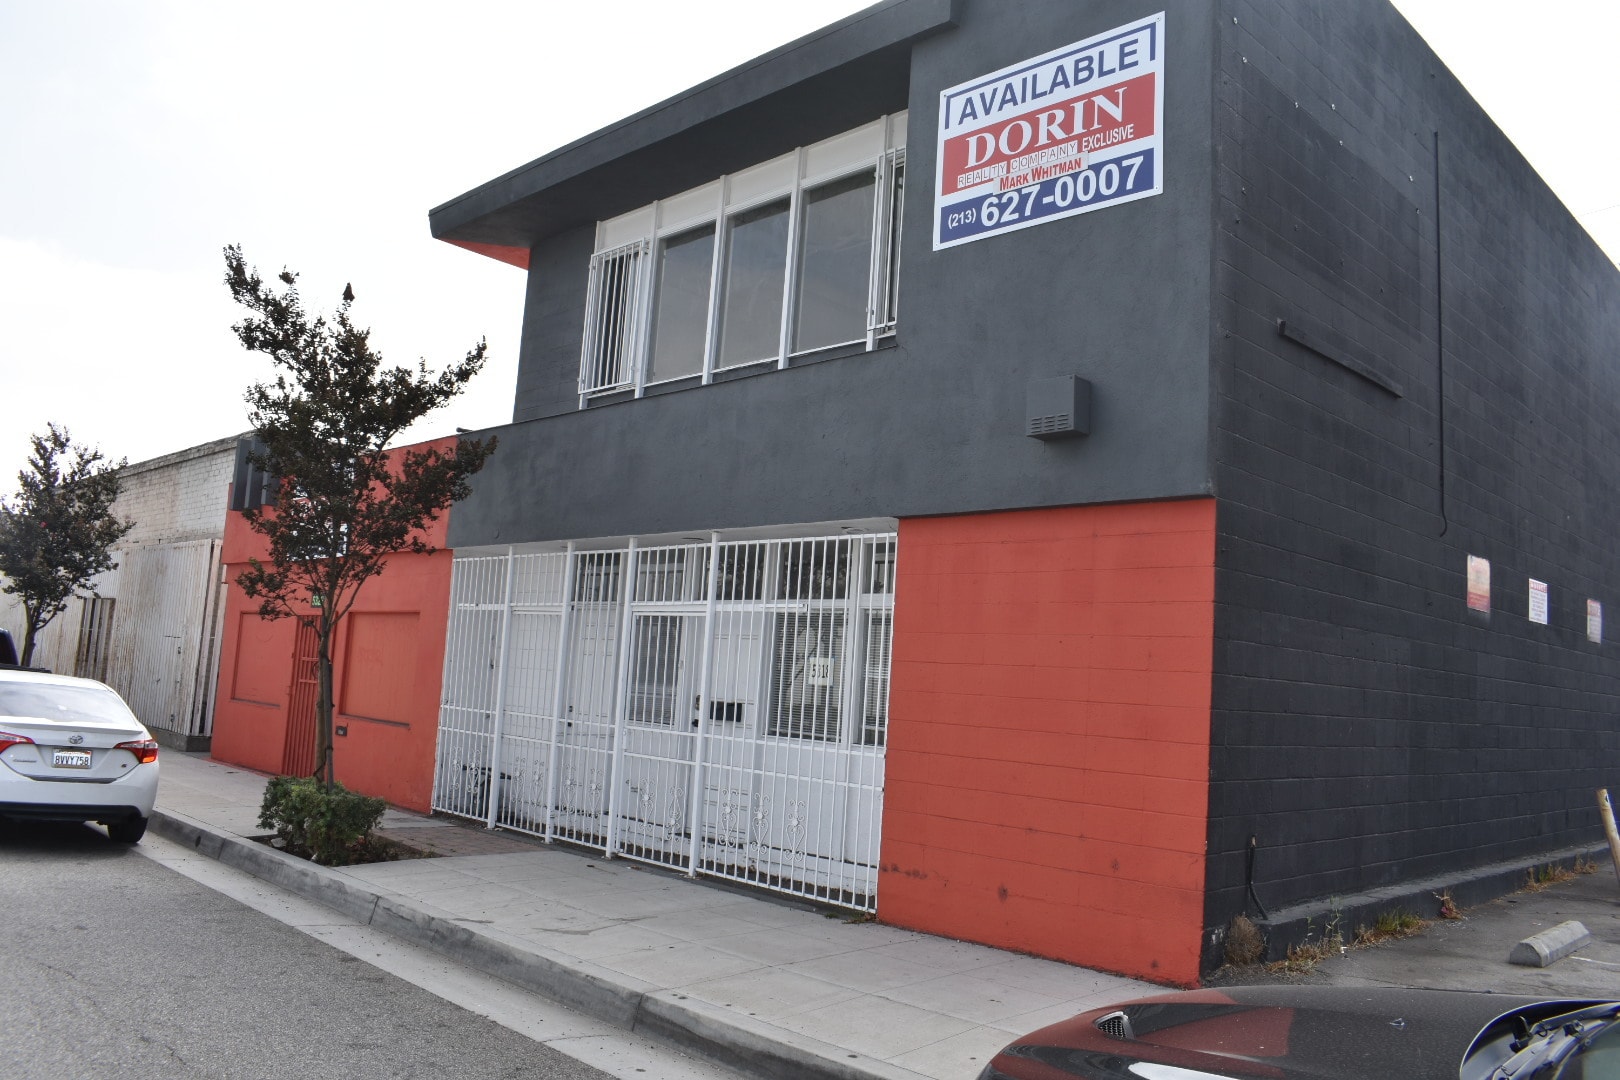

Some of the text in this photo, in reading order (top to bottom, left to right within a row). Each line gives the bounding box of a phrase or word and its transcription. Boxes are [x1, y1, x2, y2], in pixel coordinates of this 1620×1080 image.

[958, 38, 1139, 125] AVAILABLE
[958, 124, 1134, 186] REALTY COMPANY EXCLUSIVE
[964, 87, 1127, 169] DORIN
[948, 155, 1144, 229] (213) 627-0007
[1000, 158, 1082, 191] MARK WHITMAN
